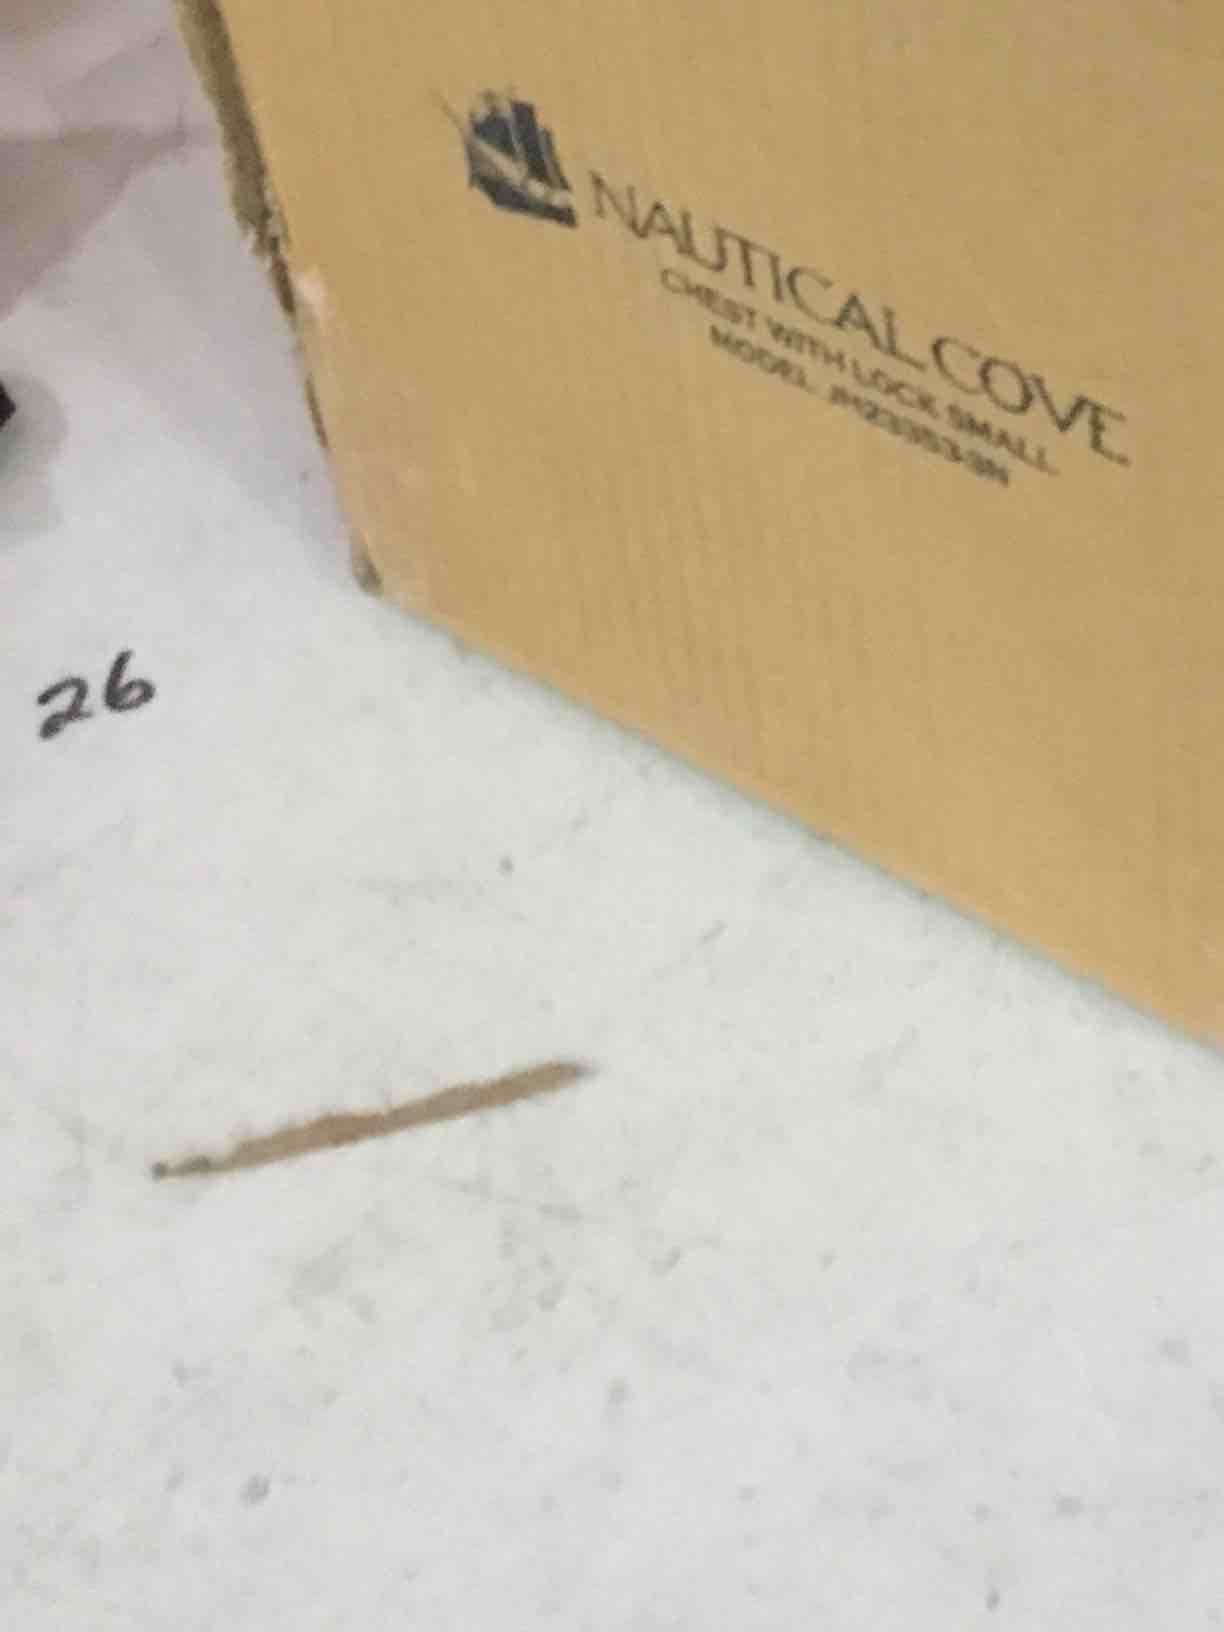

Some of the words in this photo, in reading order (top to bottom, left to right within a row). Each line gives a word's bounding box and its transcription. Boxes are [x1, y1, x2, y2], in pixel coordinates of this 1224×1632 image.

[589, 171, 927, 372] NAUTICAL
[932, 335, 1130, 466] COVE
[660, 268, 757, 330] CHEST
[765, 316, 846, 372] WITH
[851, 357, 939, 419] LOCK
[947, 402, 1060, 476] SMALL
[37, 649, 156, 739] 26
